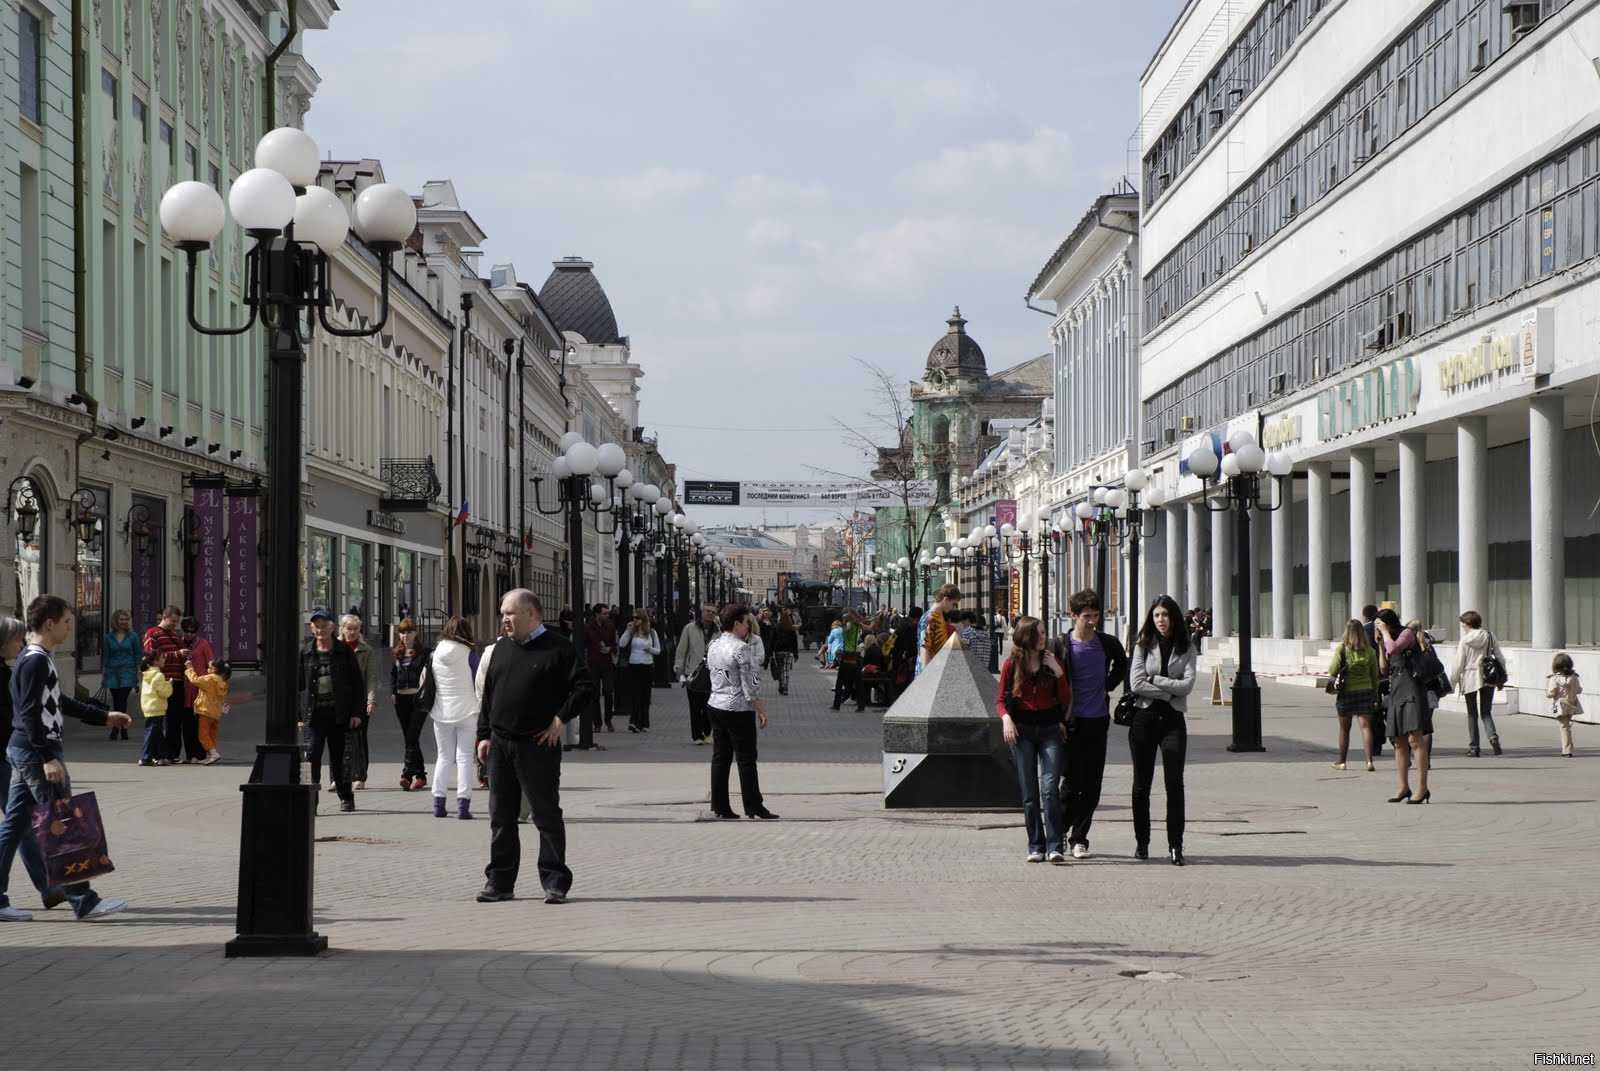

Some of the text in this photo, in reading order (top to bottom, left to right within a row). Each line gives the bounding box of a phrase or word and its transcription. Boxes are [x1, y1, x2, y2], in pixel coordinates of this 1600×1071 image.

[746, 492, 778, 500] ПОСЛЕДНИЙ
[832, 492, 847, 500] ВОРОВ
[203, 516, 214, 587] МУЖСКАЯ
[239, 521, 248, 650] АКСЕССУАРЫ
